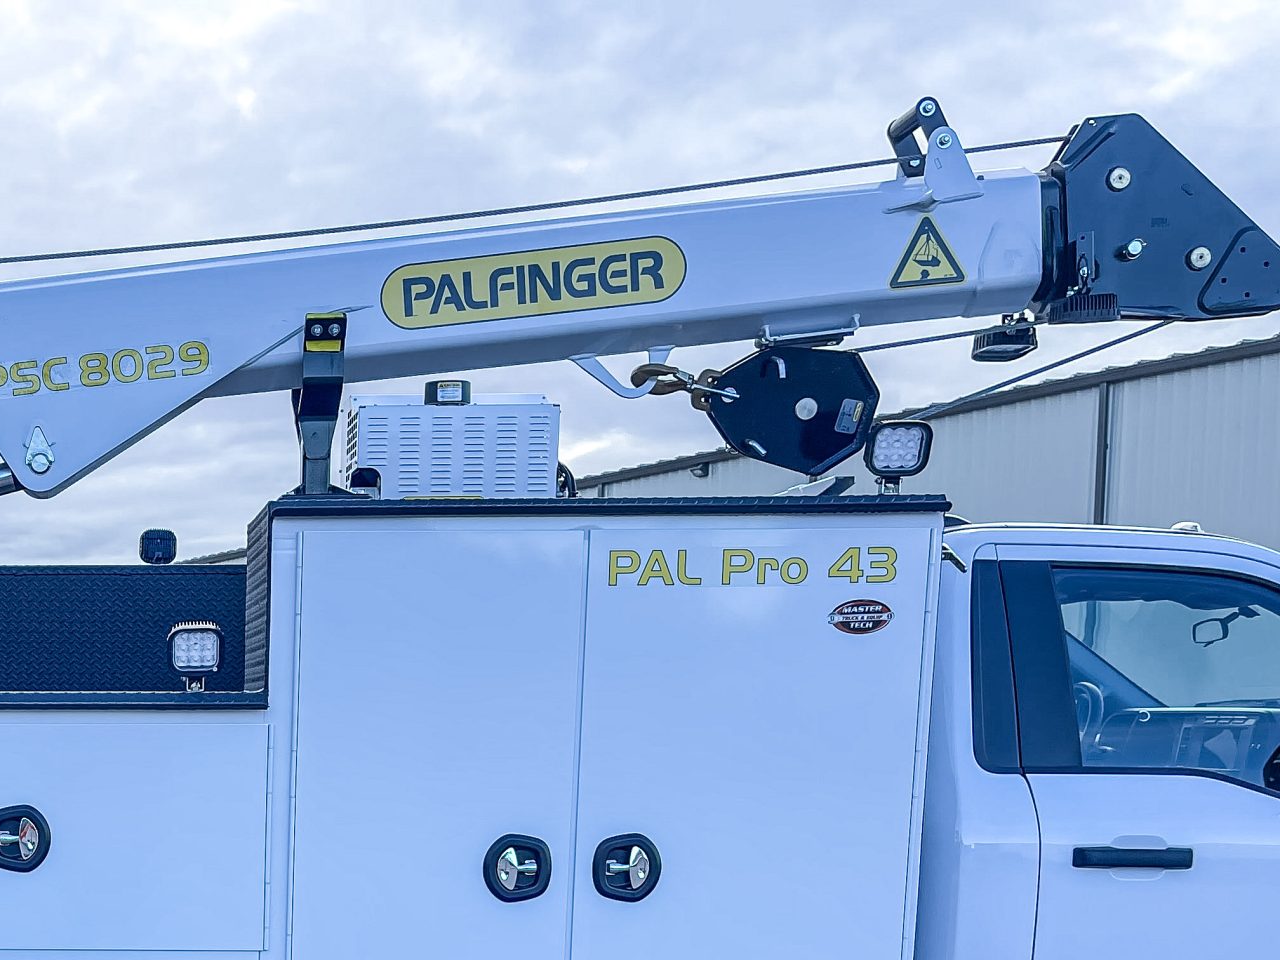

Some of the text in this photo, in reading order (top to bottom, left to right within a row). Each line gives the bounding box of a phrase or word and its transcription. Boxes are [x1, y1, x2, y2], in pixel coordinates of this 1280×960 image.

[402, 250, 664, 317] PALFINGER
[78, 340, 210, 387] 8029
[608, 546, 897, 586] PAL Pro 43
